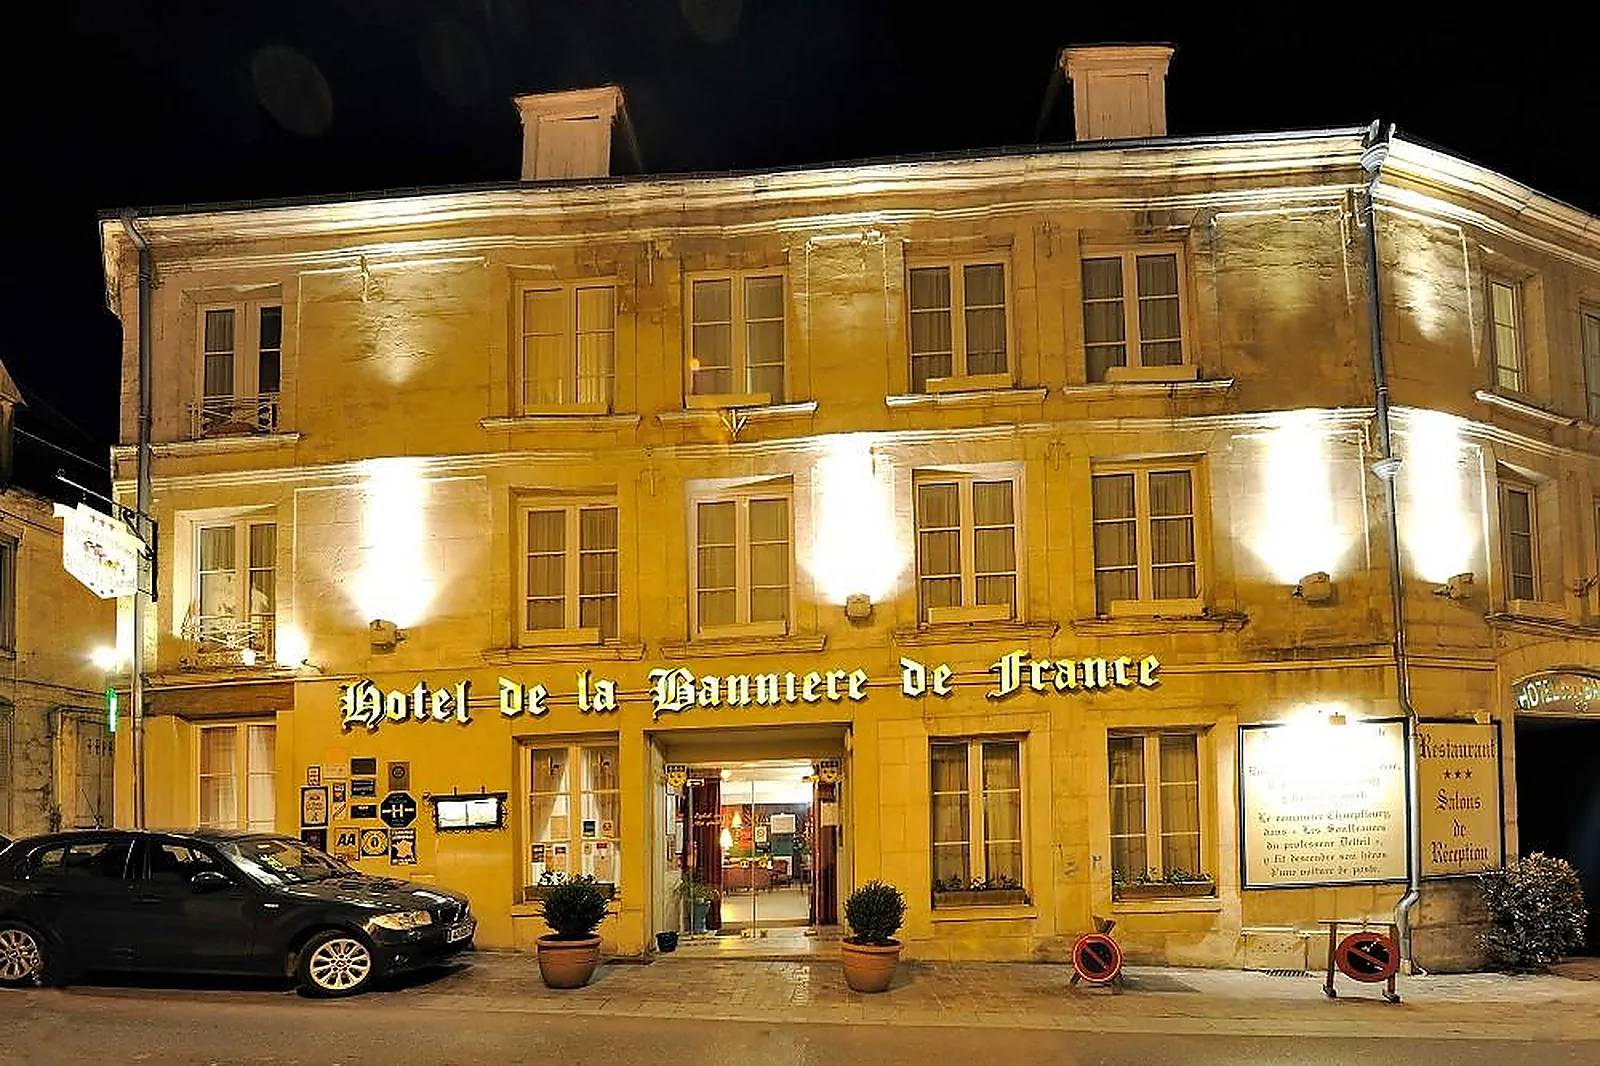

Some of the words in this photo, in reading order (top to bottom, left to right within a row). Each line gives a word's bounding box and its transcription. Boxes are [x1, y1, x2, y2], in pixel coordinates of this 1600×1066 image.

[340, 679, 471, 729] Hotel
[499, 677, 548, 715] de
[577, 670, 617, 711] la
[901, 657, 953, 696] de
[987, 650, 1161, 698] France
[1419, 733, 1495, 759] Restaurant
[1435, 788, 1481, 810] Salons
[1453, 819, 1466, 836] de
[336, 834, 356, 845] AA
